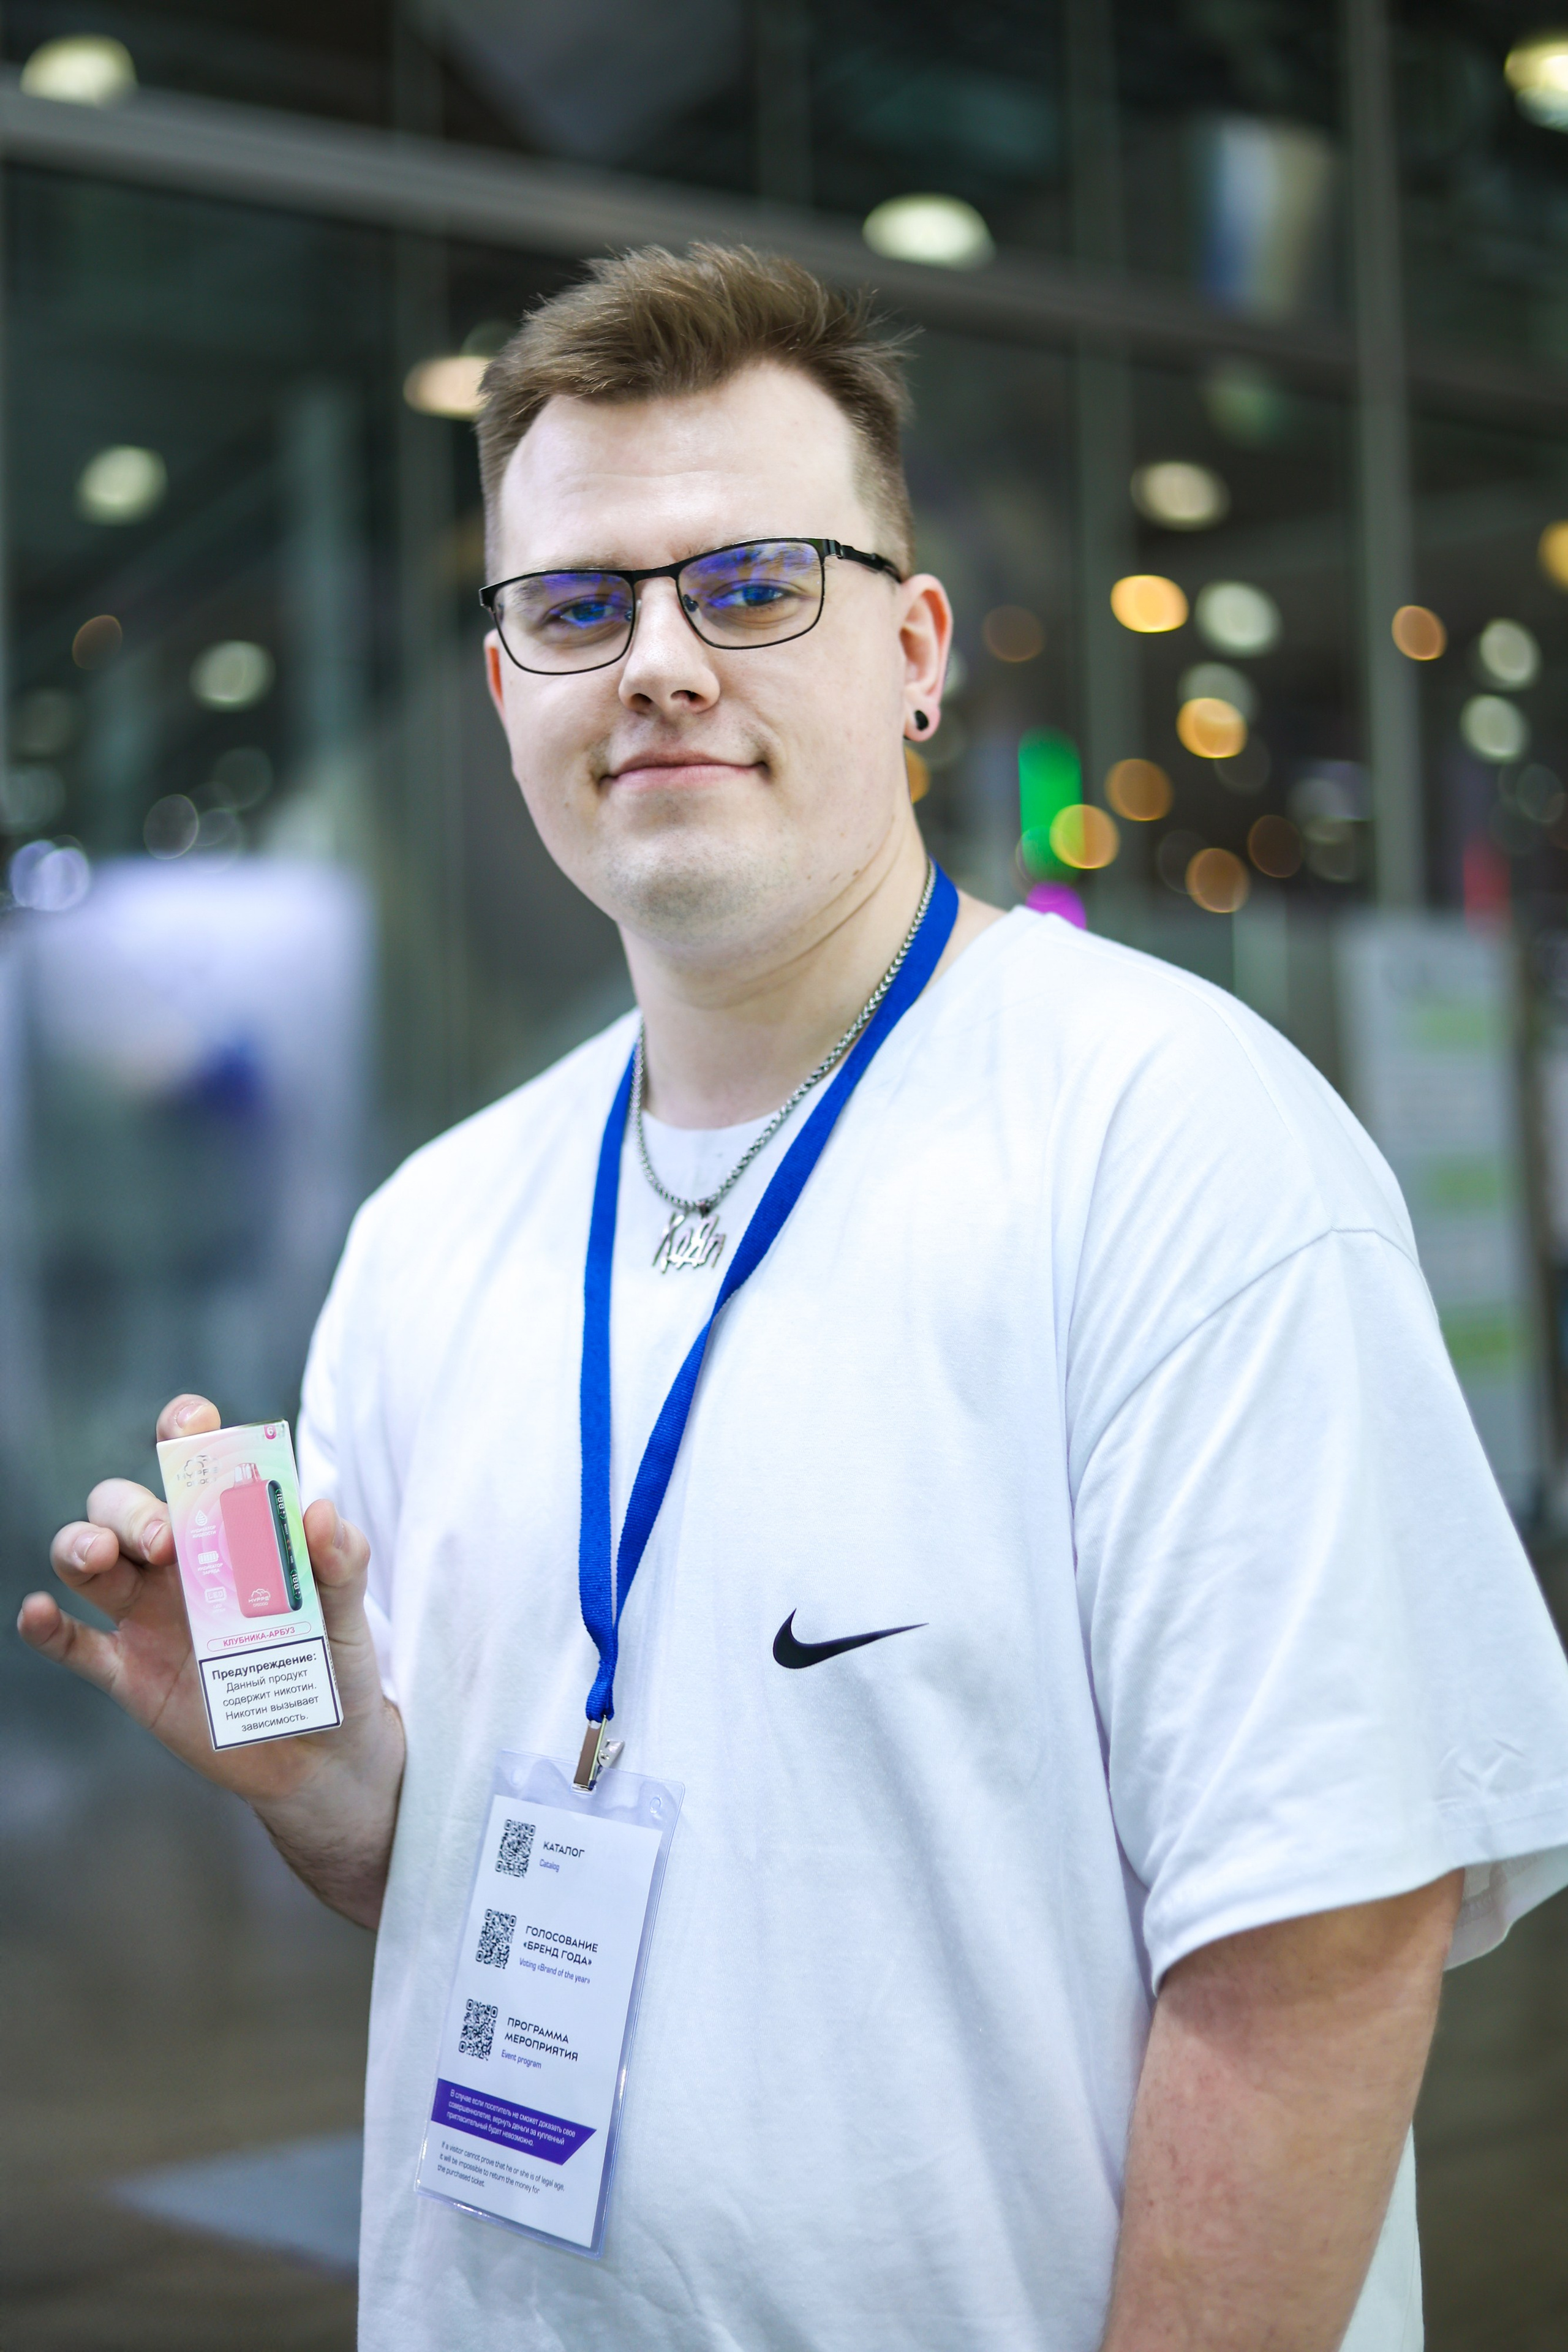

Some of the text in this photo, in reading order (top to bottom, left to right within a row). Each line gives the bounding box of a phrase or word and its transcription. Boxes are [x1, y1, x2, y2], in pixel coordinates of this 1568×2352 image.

[223, 1627, 295, 1647] КЛУБНИКА-АРБУЗ
[212, 1653, 317, 1680] Предупреждение:
[227, 1670, 308, 1693] Данный продукт
[223, 1683, 317, 1706] содержит никотин.
[225, 1696, 319, 1721] Никотин вызывает
[241, 1714, 308, 1732] зависимость.
[543, 1841, 585, 1858] КАТАЛОГ
[539, 1859, 560, 1872] Catalog
[526, 1926, 598, 1953] ГОЛОСОВАНИЕ
[523, 1941, 592, 1966] «БРЕНД ГОДА»
[519, 1958, 537, 1971] Voting
[537, 1963, 557, 1975] «Brand
[557, 1969, 564, 1977] of
[565, 1971, 574, 1980] the
[507, 2017, 568, 2043] ПРОГРАММА
[505, 2032, 579, 2062] МЕРОПРИЯТИЯ
[501, 2049, 541, 2069] Event program
[455, 2092, 472, 2103] случае
[472, 2098, 484, 2107] если
[484, 2102, 511, 2116] посетитель
[519, 2114, 538, 2125] сможет
[538, 2120, 562, 2133] доказать
[563, 2128, 575, 2138] свое
[488, 2124, 502, 2135] будет
[492, 2116, 511, 2127] вернуть
[512, 2123, 529, 2133] деньги
[537, 2132, 565, 2145] купленный
[446, 2168, 470, 2181] purchased
[450, 2146, 464, 2154] visitor
[464, 2150, 480, 2161] cannot
[481, 2157, 494, 2166] prove
[495, 2161, 505, 2170] that
[506, 2163, 512, 2173] he
[520, 2169, 529, 2178] she
[541, 2176, 553, 2187] legal
[489, 2172, 505, 2182] return
[515, 2180, 532, 2193] money
